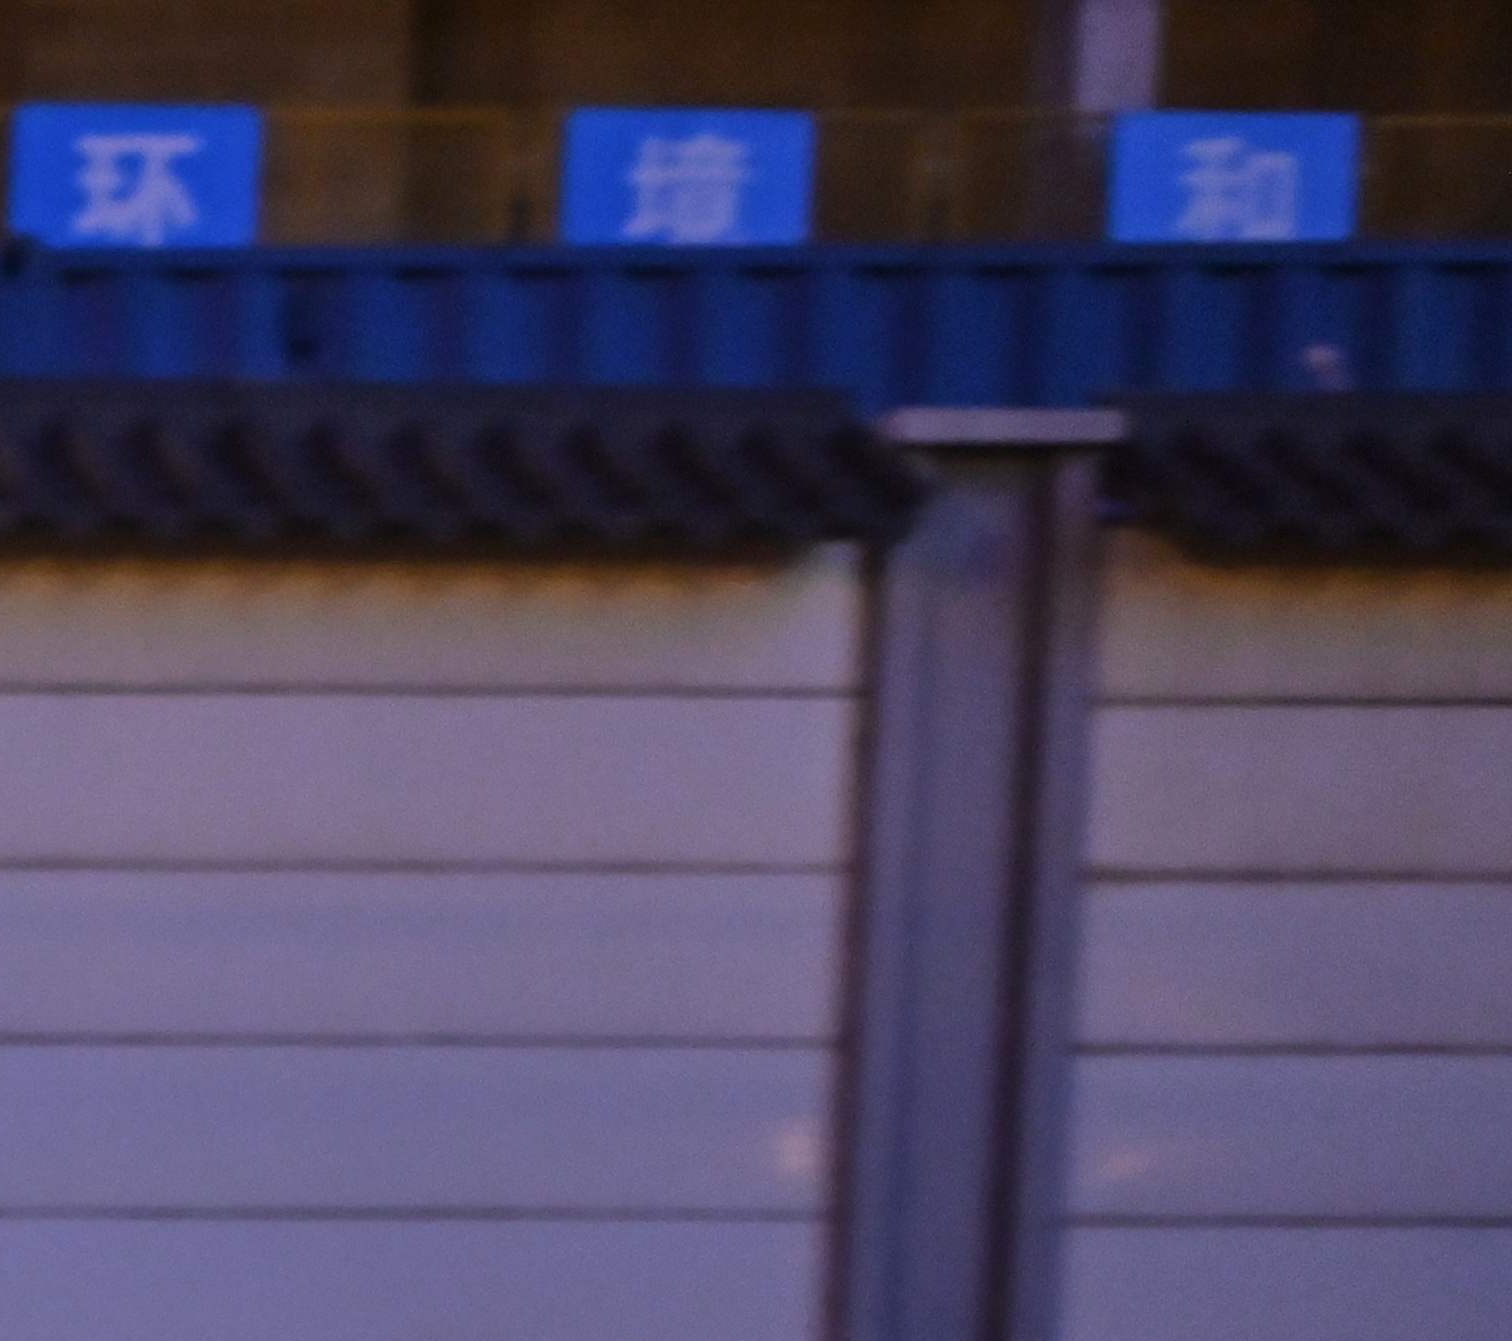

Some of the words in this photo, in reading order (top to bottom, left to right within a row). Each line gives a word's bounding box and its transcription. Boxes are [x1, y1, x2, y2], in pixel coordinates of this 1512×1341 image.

[72, 135, 198, 247] 环
[624, 135, 749, 244] 境
[1176, 136, 1299, 241] 和
